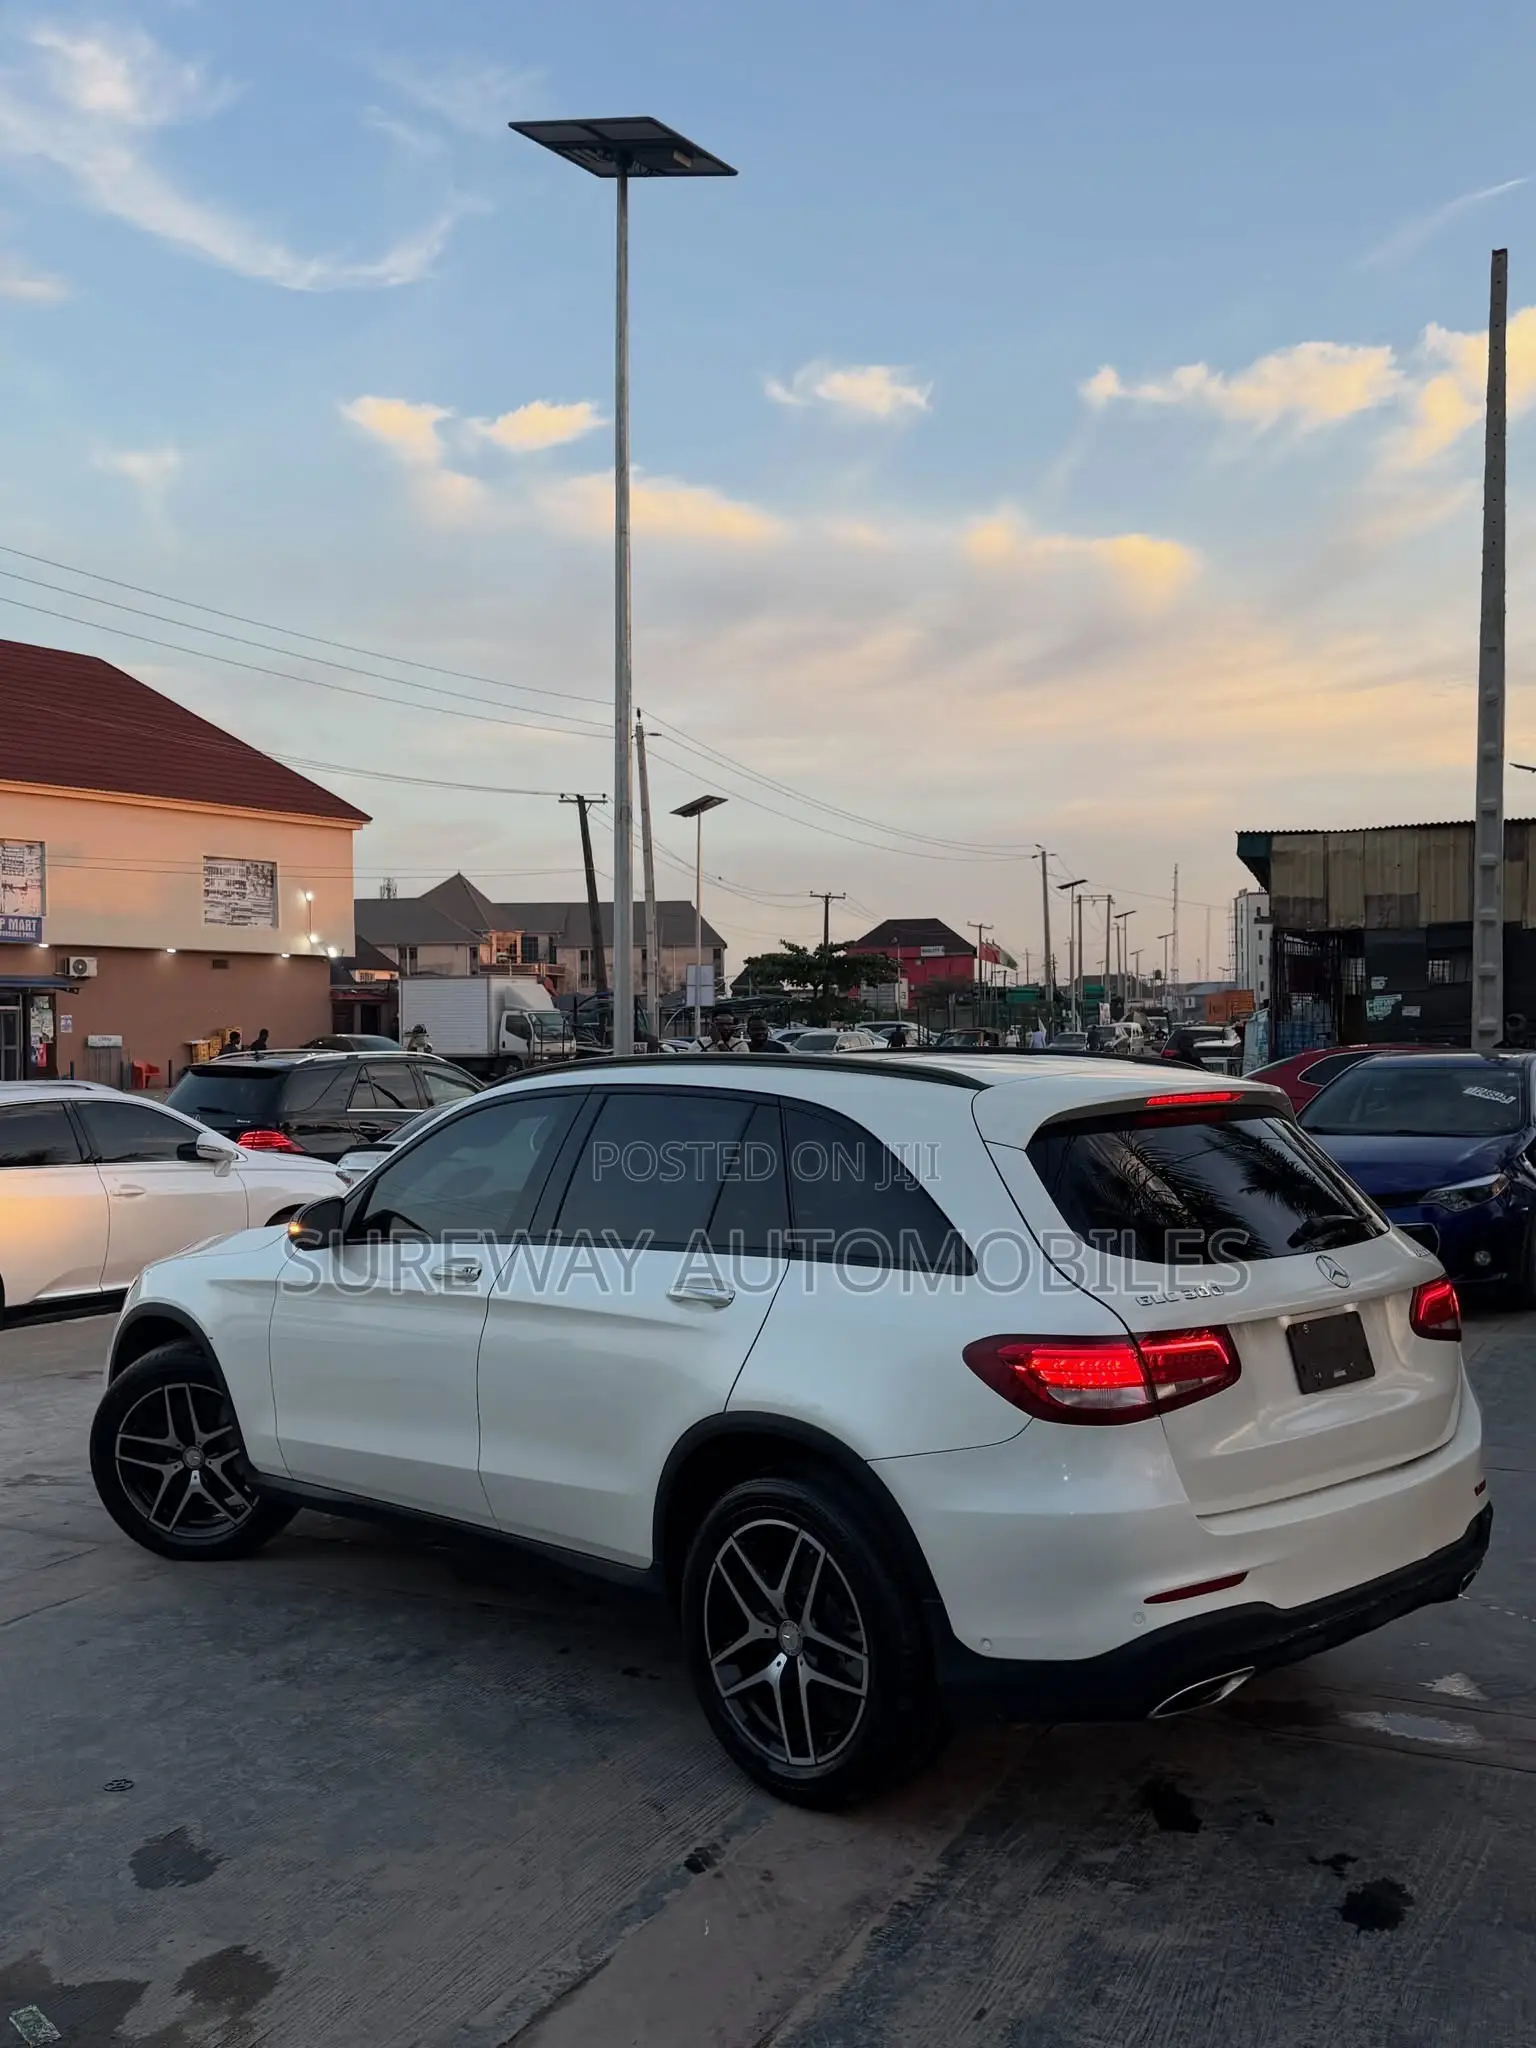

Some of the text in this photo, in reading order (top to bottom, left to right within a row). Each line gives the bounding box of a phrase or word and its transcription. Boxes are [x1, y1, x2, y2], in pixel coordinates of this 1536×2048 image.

[8, 918, 37, 931] MART
[1135, 1284, 1225, 1306] GLC 300
